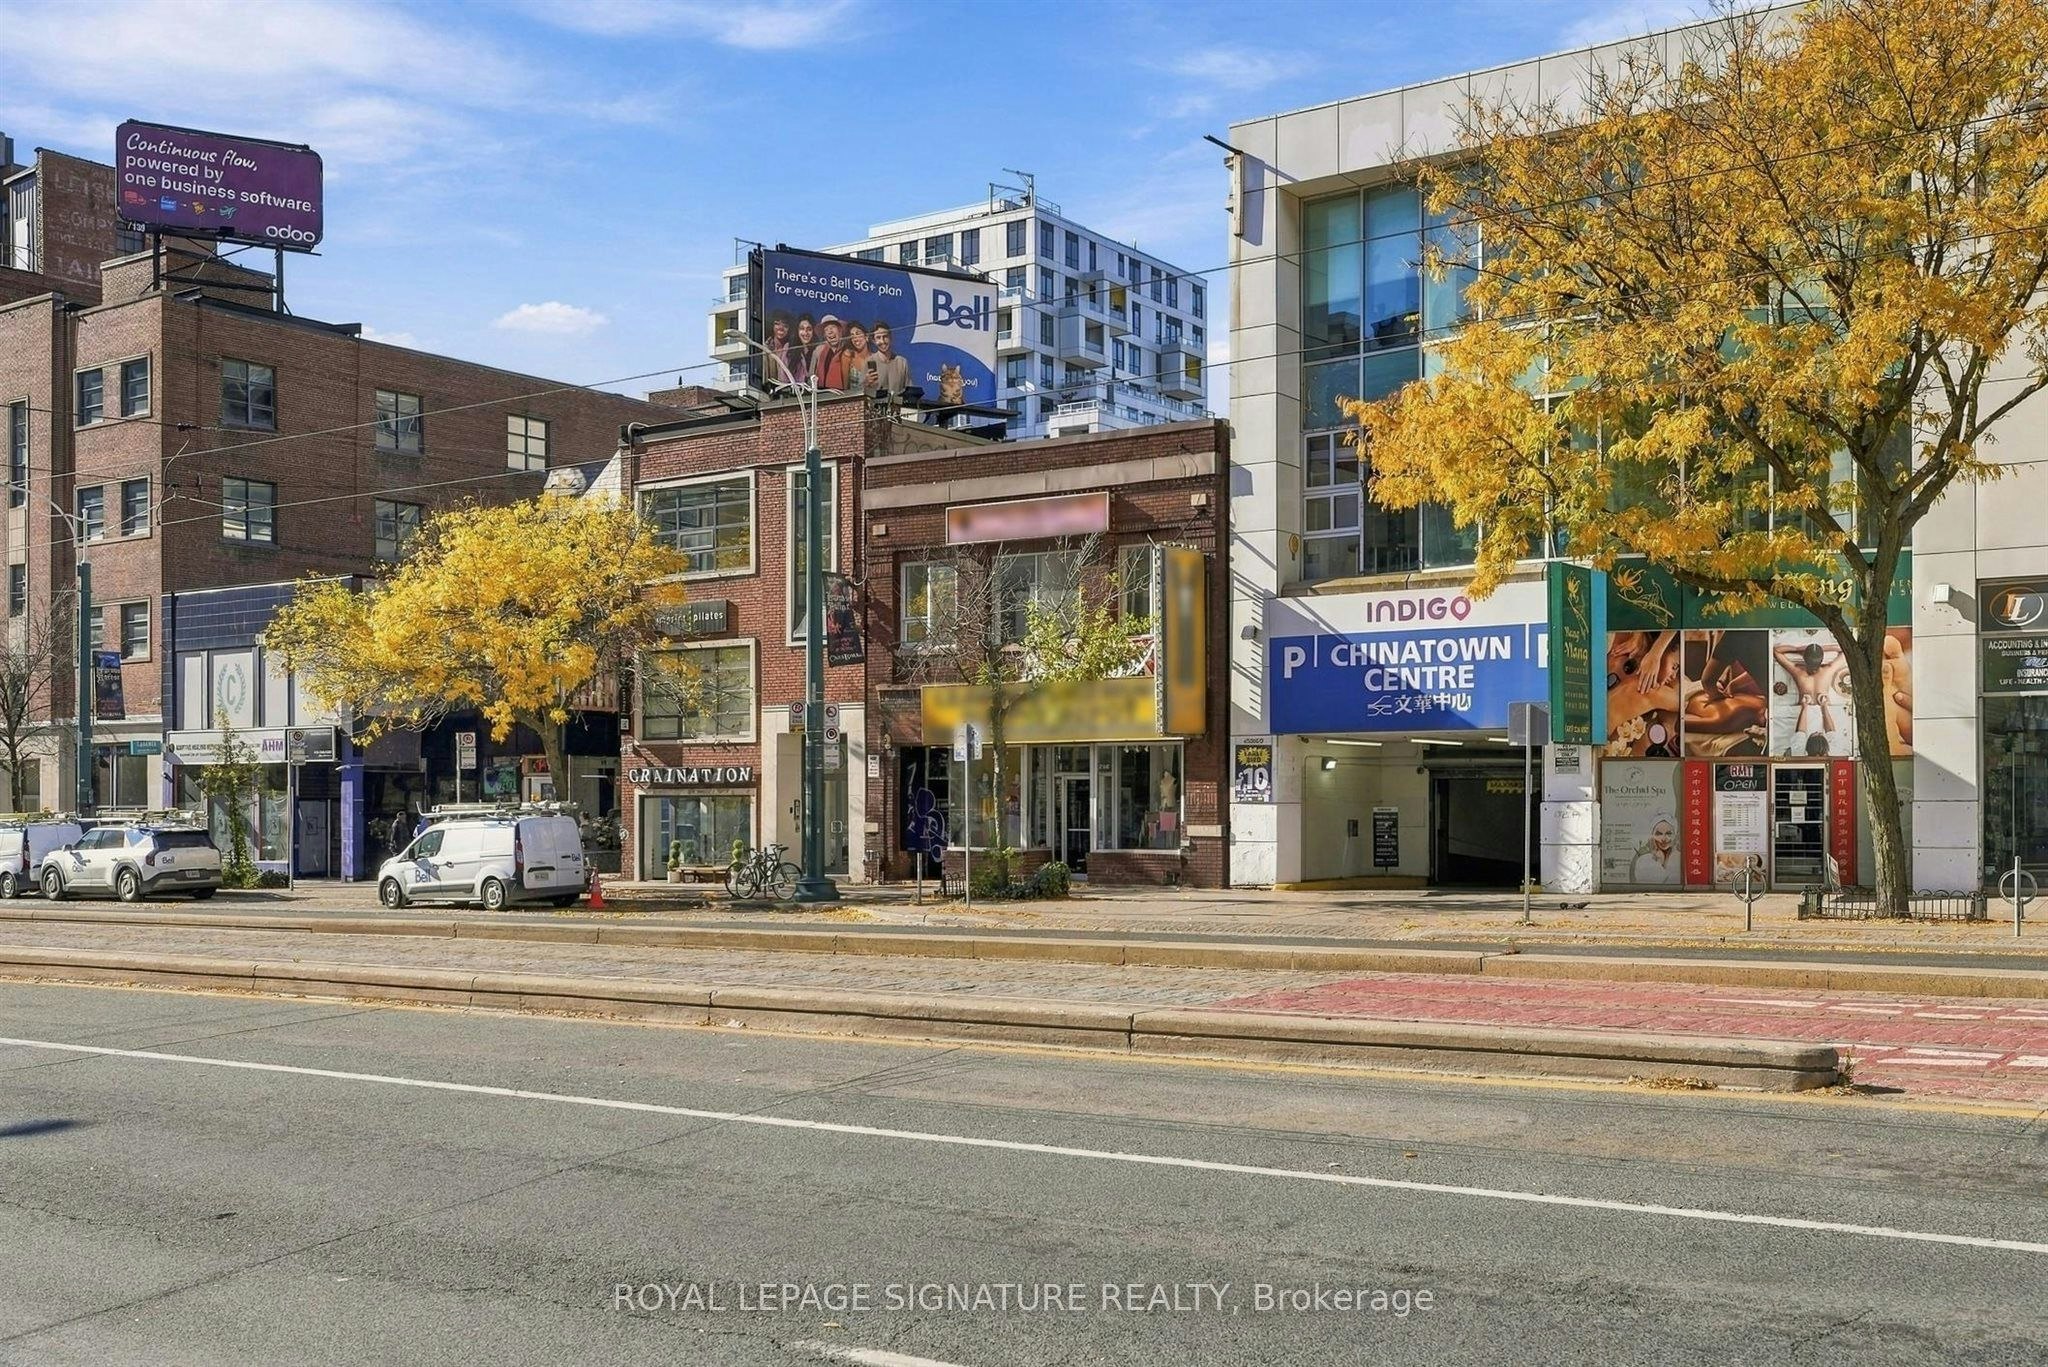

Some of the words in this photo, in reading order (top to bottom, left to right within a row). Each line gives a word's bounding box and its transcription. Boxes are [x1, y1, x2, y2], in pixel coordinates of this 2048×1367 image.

[126, 132, 218, 163] Continuous
[222, 149, 257, 171] flow,
[125, 155, 199, 177] powered
[204, 165, 224, 183] by
[124, 172, 157, 187] one
[161, 175, 236, 200] business
[240, 191, 316, 213] software.
[265, 224, 316, 242] odoo
[774, 267, 817, 284] There's
[830, 275, 851, 290] Bell
[853, 279, 876, 292] 5G+
[878, 284, 902, 297] plan
[774, 282, 792, 294] for
[794, 287, 851, 304] everyone.
[932, 288, 990, 332] Bell
[693, 611, 724, 622] pilates
[1367, 596, 1471, 622] INDIGO
[1988, 640, 2033, 650] ACCOUNTING
[1283, 646, 1307, 679] P
[1330, 635, 1511, 667] CHINATOWN
[1363, 664, 1475, 692] CENTRE
[262, 739, 284, 752] AHM
[629, 766, 751, 783] GRAINATION
[1604, 786, 1619, 795] The
[1620, 785, 1650, 795] Orchid
[1723, 779, 1758, 791] OPEN
[162, 856, 175, 864] Bell
[572, 852, 581, 862] Bell
[415, 868, 431, 883] Bell
